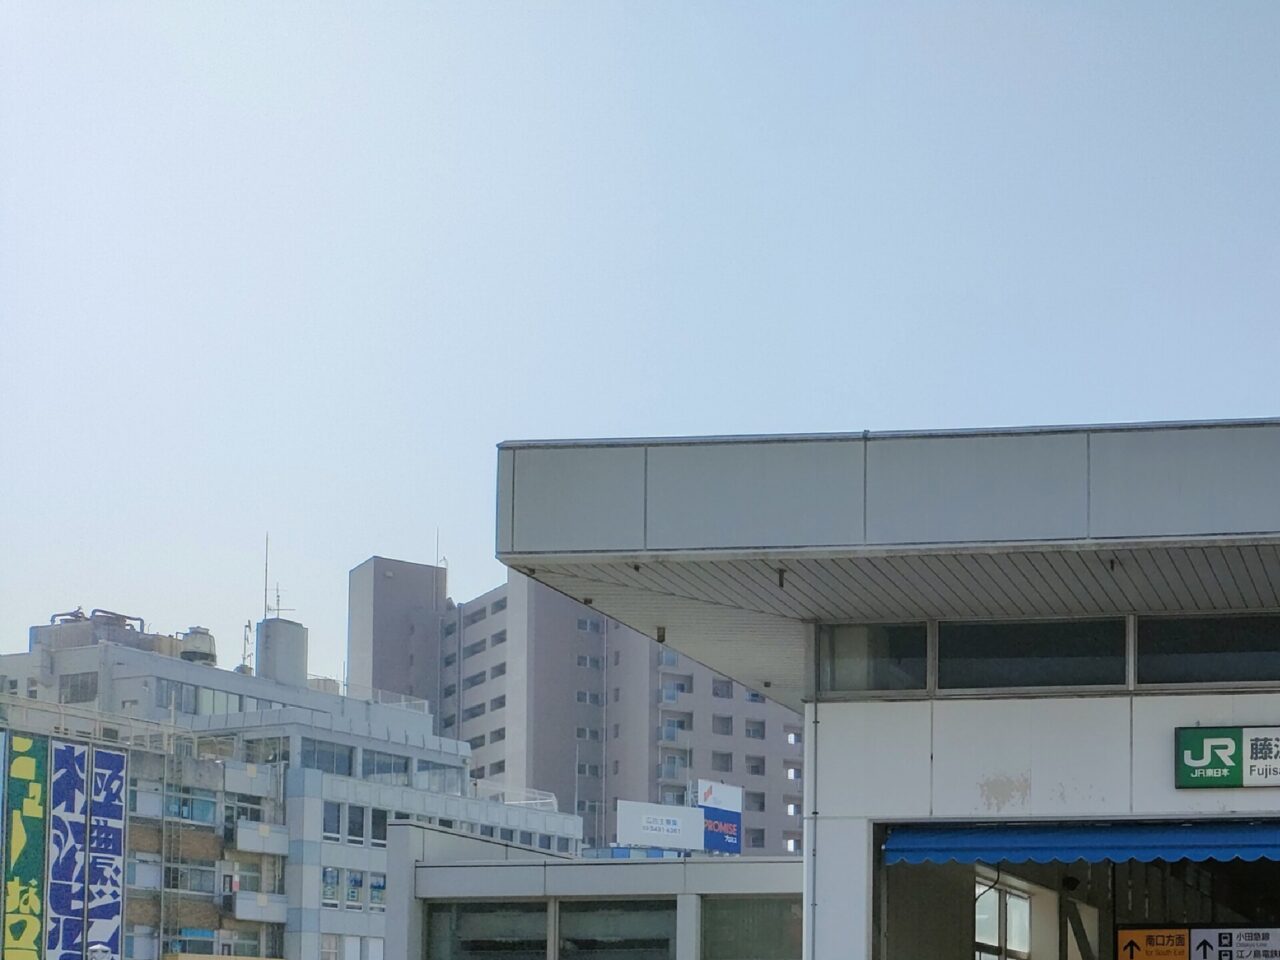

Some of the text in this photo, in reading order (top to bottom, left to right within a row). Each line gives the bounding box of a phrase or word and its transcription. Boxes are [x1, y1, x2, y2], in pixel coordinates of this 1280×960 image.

[1184, 738, 1236, 767] JR
[1190, 768, 1230, 778] JR東日本
[704, 819, 737, 835] PROMISE
[1145, 934, 1185, 947] 南口方面
[1235, 932, 1270, 941] 小田急線
